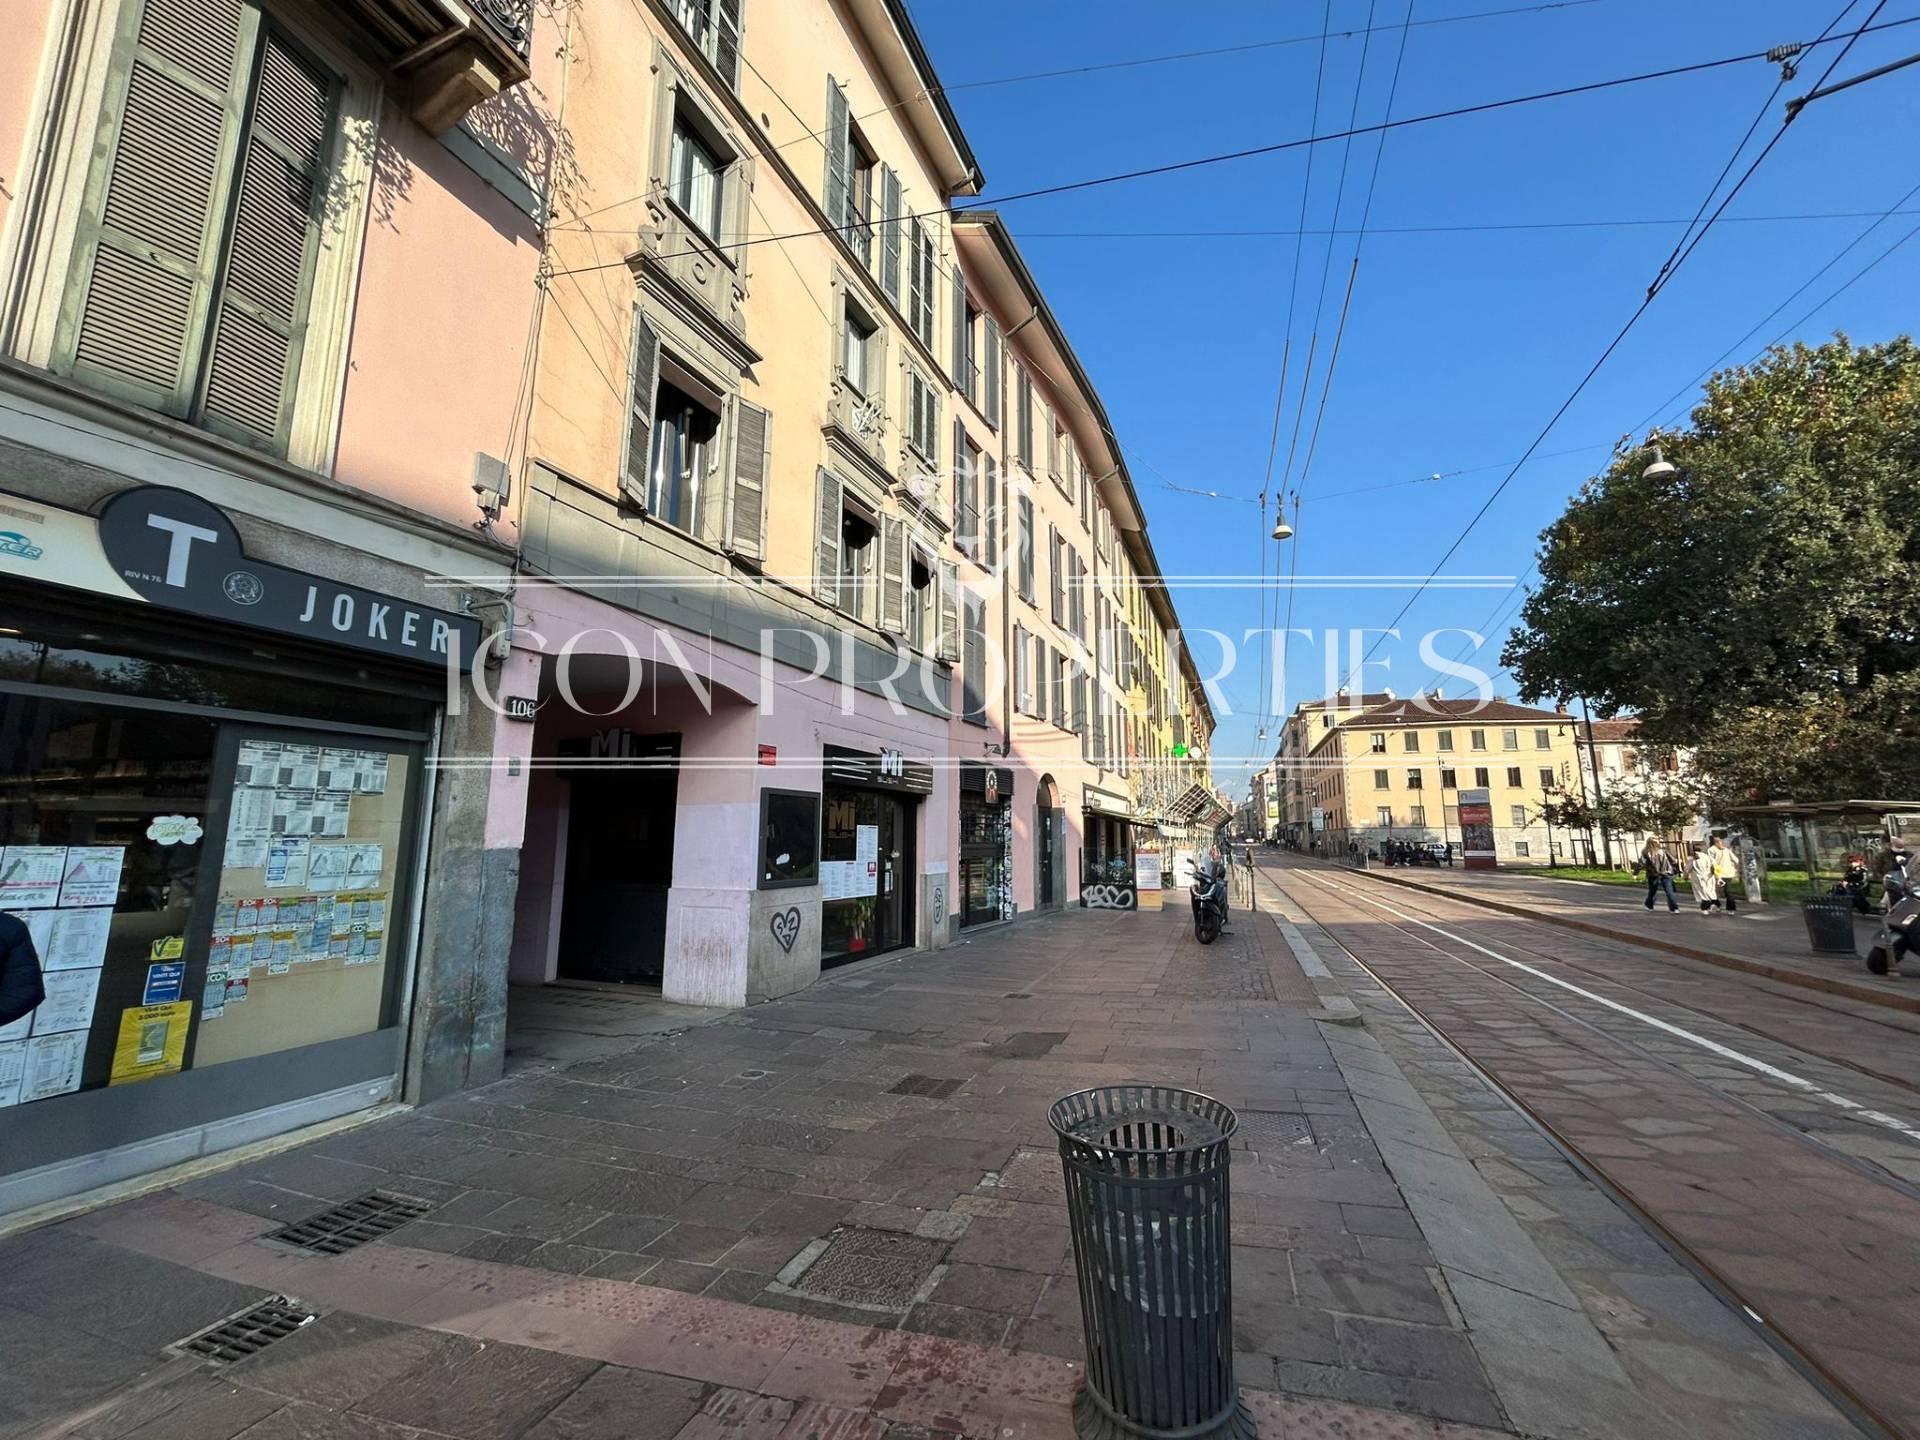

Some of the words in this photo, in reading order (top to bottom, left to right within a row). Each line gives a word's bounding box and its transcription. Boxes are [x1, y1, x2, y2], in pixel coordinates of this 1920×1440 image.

[147, 513, 218, 588] T
[299, 585, 448, 654] JOKER
[512, 699, 536, 718] 106
